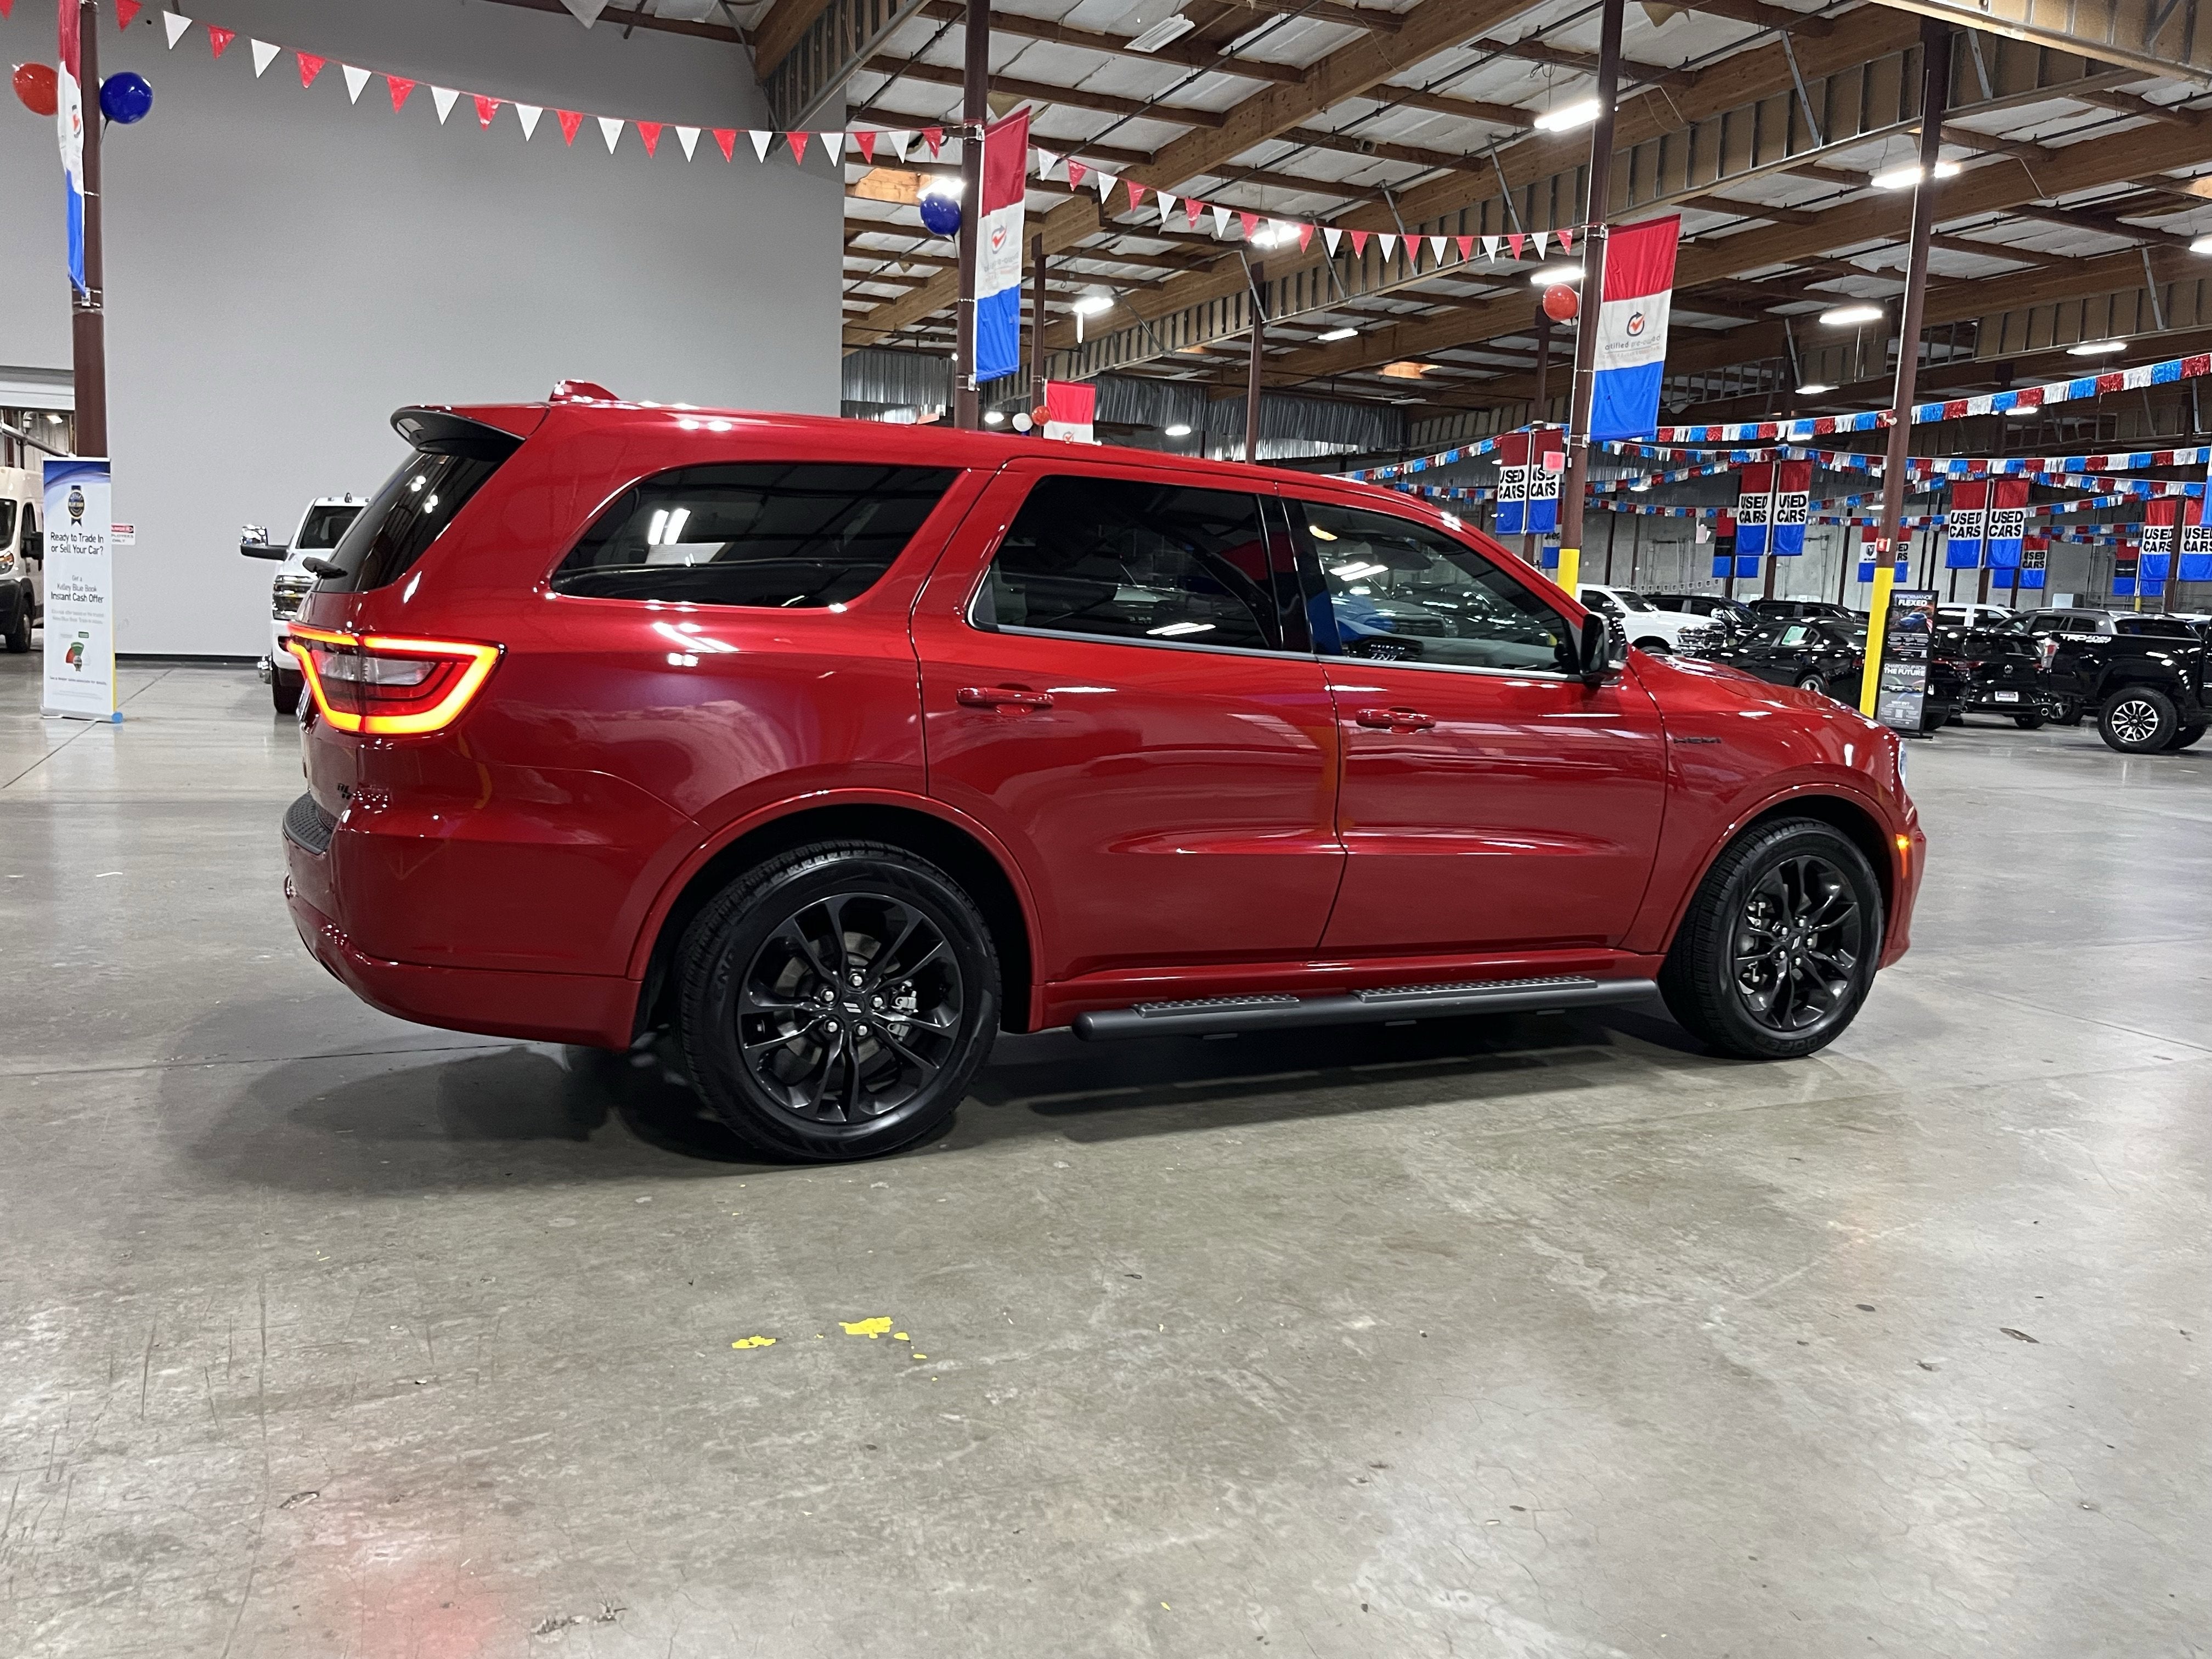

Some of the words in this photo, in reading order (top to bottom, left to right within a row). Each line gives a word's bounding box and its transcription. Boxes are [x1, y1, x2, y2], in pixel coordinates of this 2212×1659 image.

[1531, 482, 1556, 496] CARS
[1741, 495, 1768, 509] USED
[1739, 510, 1767, 523] CARS
[1777, 509, 1806, 523] CARS
[1951, 512, 1982, 524] USED
[1991, 511, 2024, 523] USED
[1950, 526, 1980, 538] CARS
[1989, 524, 2022, 537] CARS
[2185, 527, 2212, 539] USE
[50, 532, 70, 543] Ready
[71, 533, 77, 541] to
[78, 533, 96, 543] Trade
[98, 534, 104, 543] In
[60, 544, 71, 553] Sell
[72, 545, 87, 554] Your
[88, 545, 104, 555] Car?
[1897, 543, 1909, 552] ED
[2143, 540, 2171, 552] CARS
[1897, 552, 1908, 561] RS
[2024, 551, 2045, 560] USED
[2022, 560, 2045, 569] CARS
[72, 583, 83, 591] Blue
[51, 591, 71, 601] Instant
[72, 592, 87, 602] Cash
[89, 594, 104, 603] Offer
[1898, 599, 1928, 607] FLEXED
